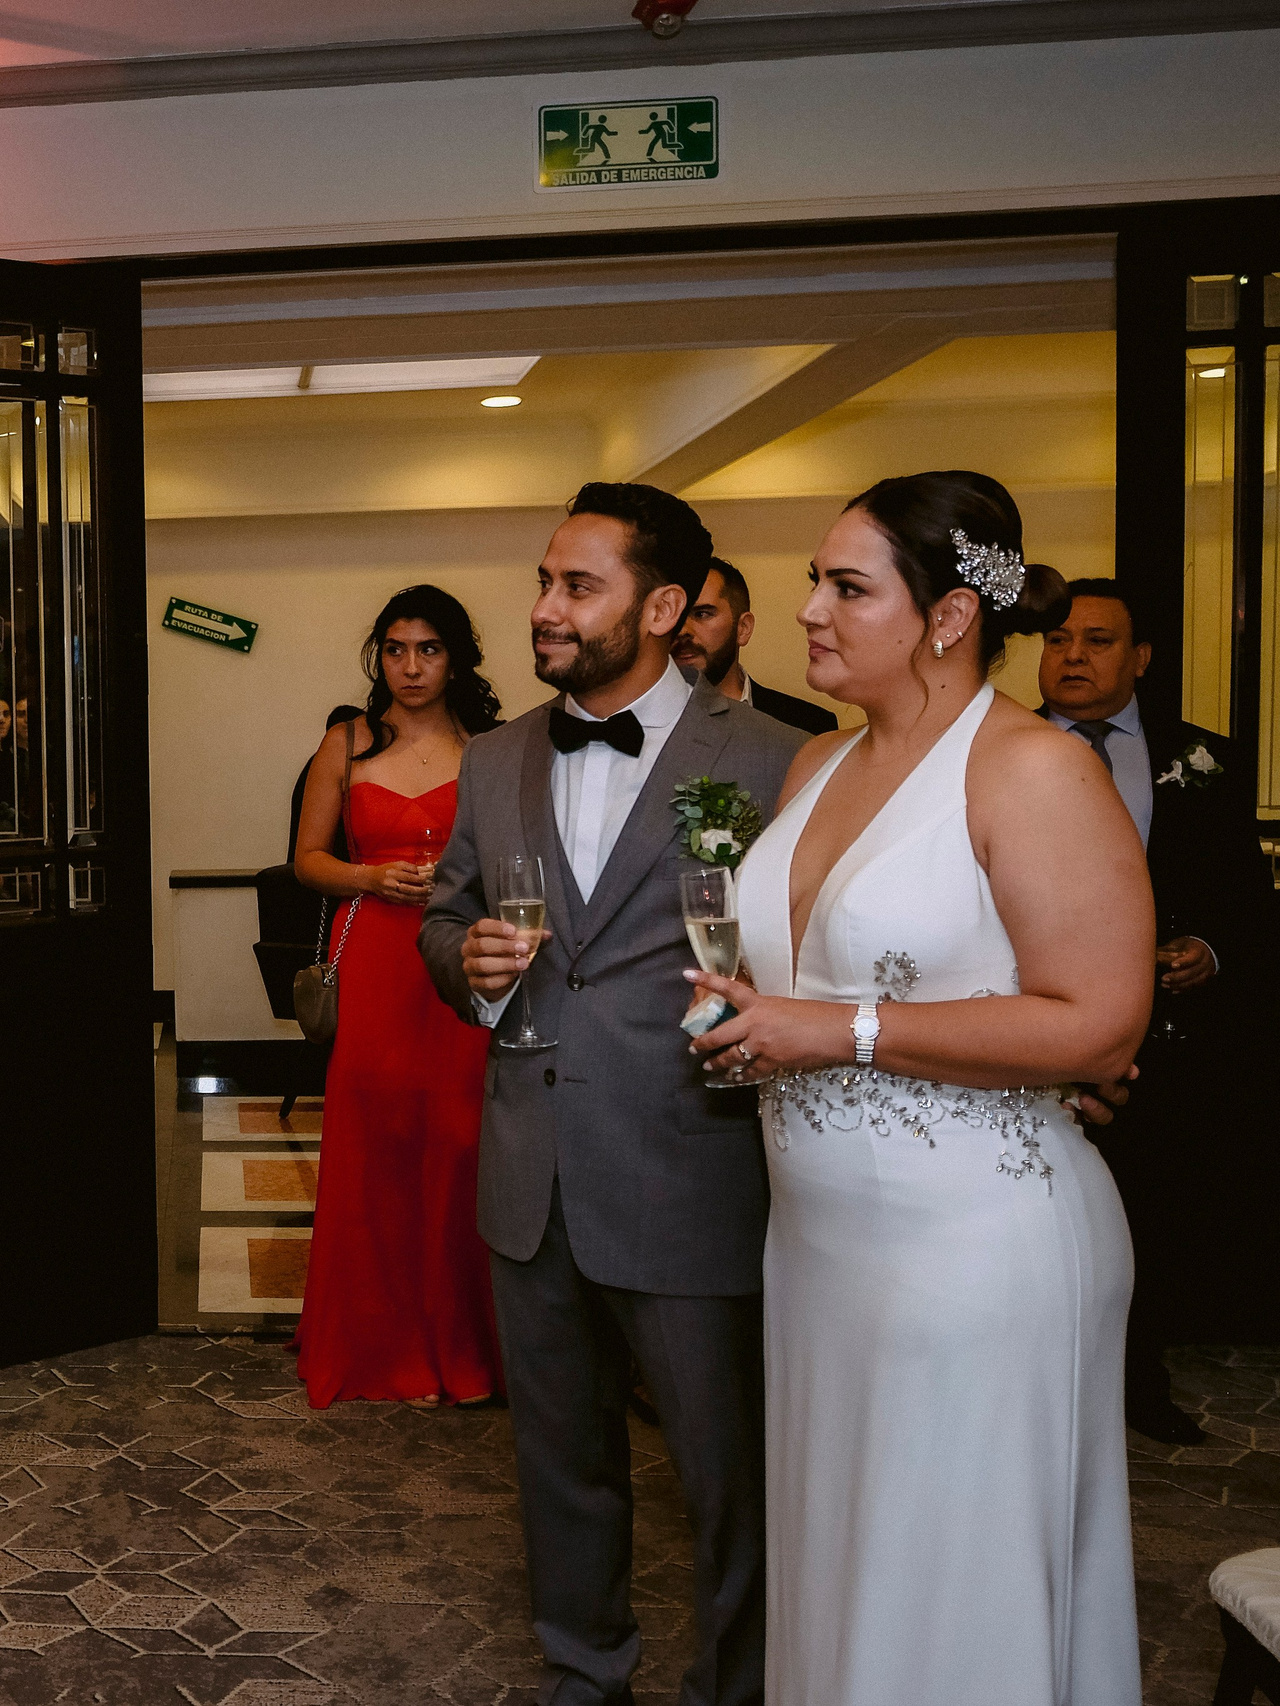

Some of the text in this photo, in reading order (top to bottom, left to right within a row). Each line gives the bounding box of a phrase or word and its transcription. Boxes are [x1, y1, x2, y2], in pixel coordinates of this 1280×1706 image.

[552, 166, 707, 186] SALIDA DE EMERGENCIA
[184, 605, 224, 623] RUTA DE
[171, 619, 227, 642] EVACUACION
